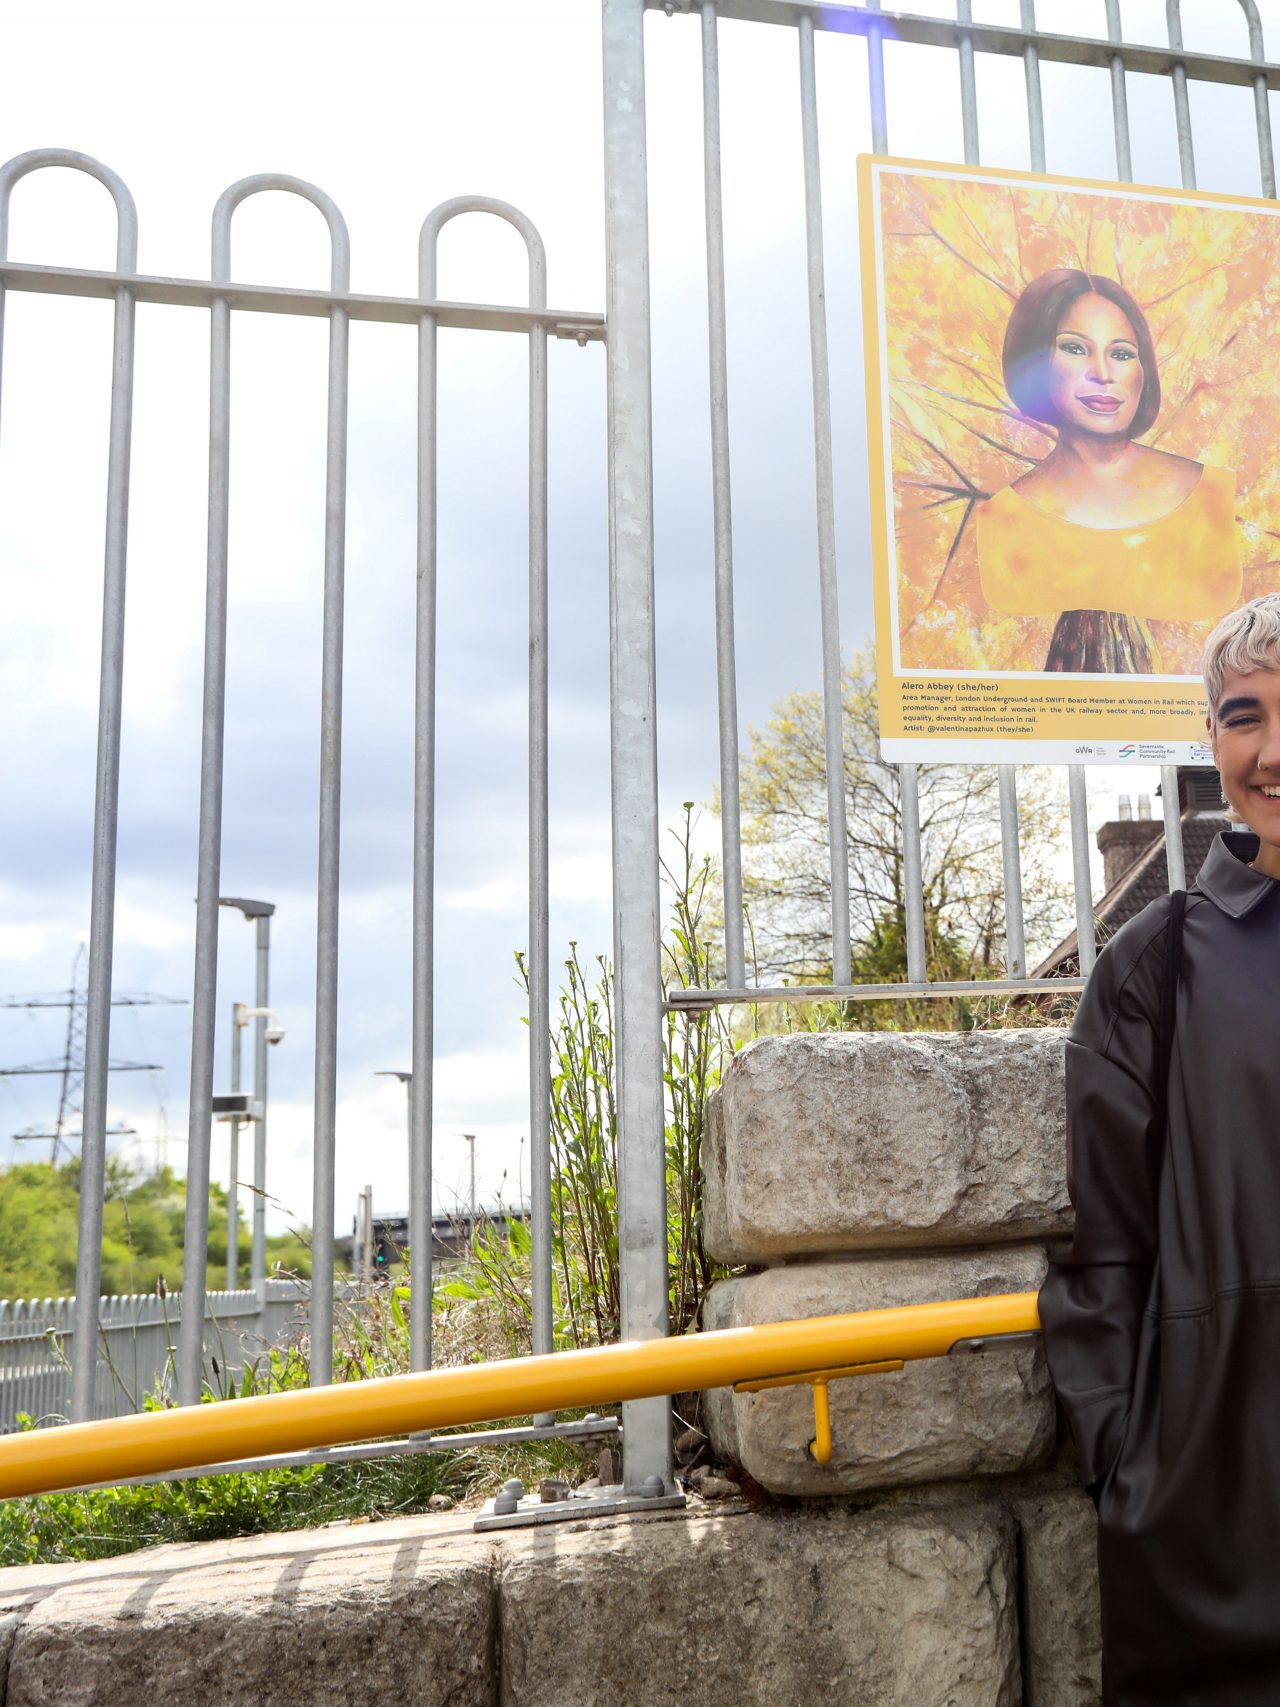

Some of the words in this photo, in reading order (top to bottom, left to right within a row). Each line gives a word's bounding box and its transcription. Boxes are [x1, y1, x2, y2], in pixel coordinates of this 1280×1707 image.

[901, 682, 924, 690] Alero
[927, 682, 954, 691] Abbey
[957, 683, 999, 691] (she/her)
[920, 694, 954, 703] Manager,
[983, 696, 1028, 704] Underground
[1075, 746, 1092, 754] GWR
